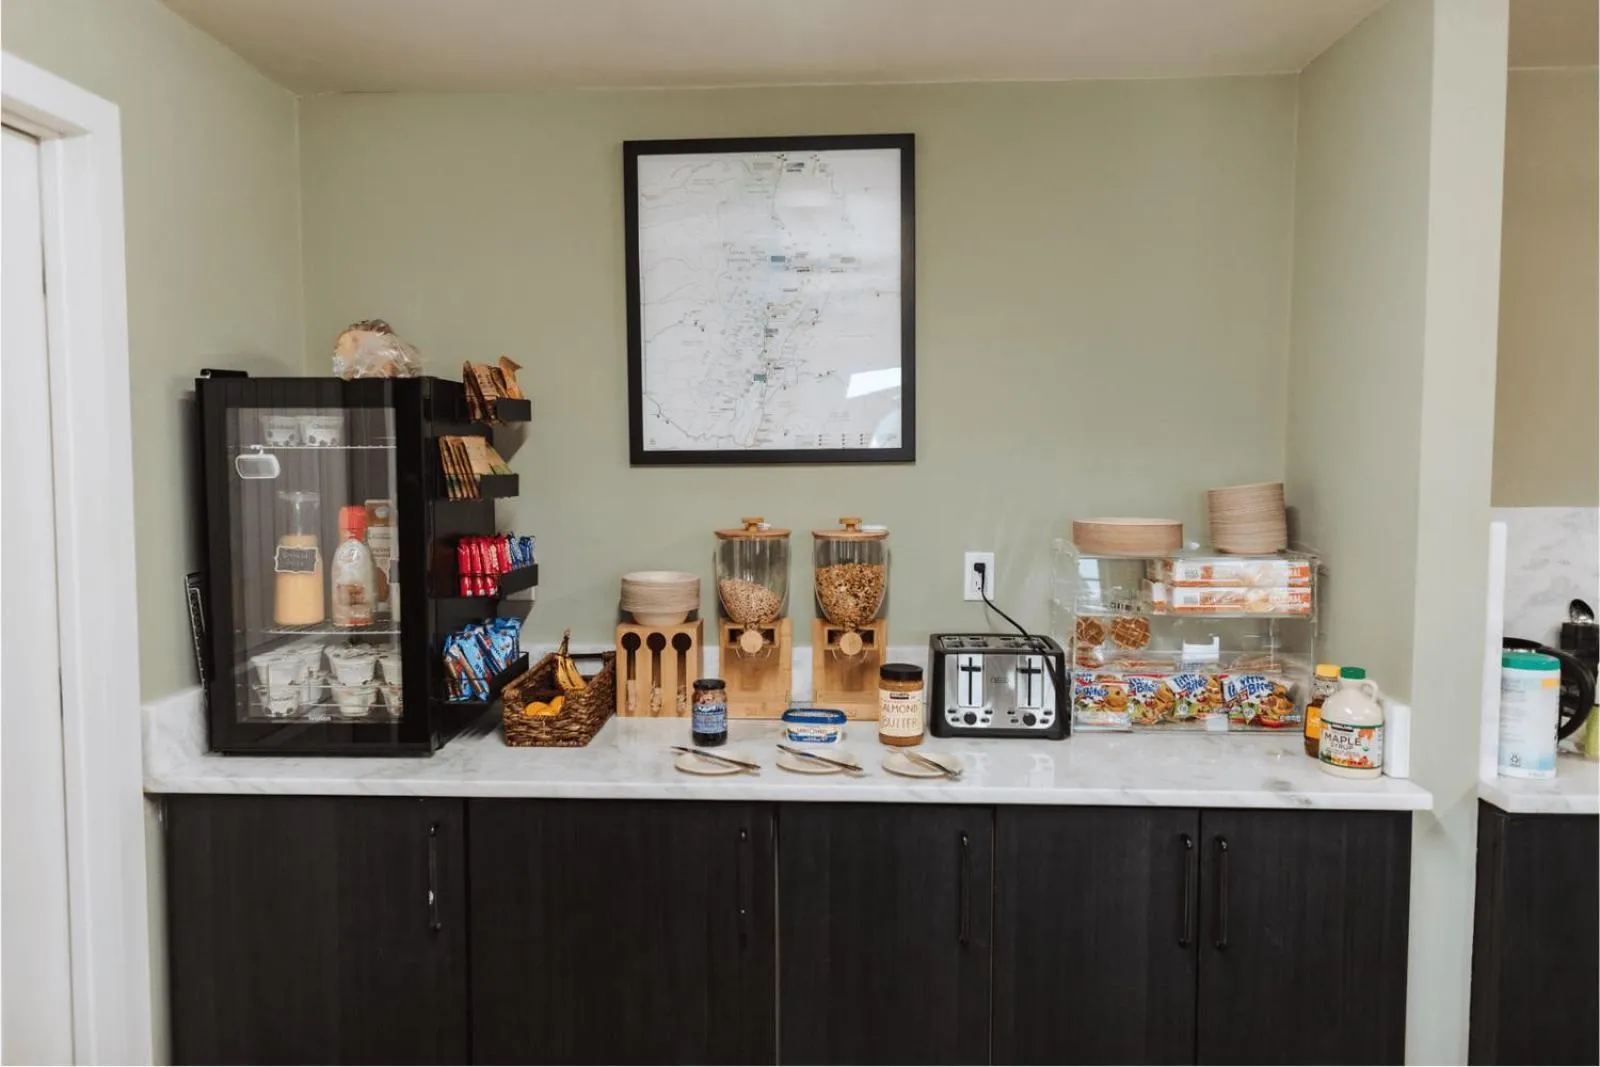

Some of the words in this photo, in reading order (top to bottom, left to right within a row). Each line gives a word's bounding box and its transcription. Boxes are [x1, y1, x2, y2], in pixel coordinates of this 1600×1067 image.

[1248, 682, 1275, 695] Bites
[882, 703, 918, 714] ALMOND
[1324, 732, 1361, 747] MAPLE
[1330, 742, 1354, 751] SYRUP
